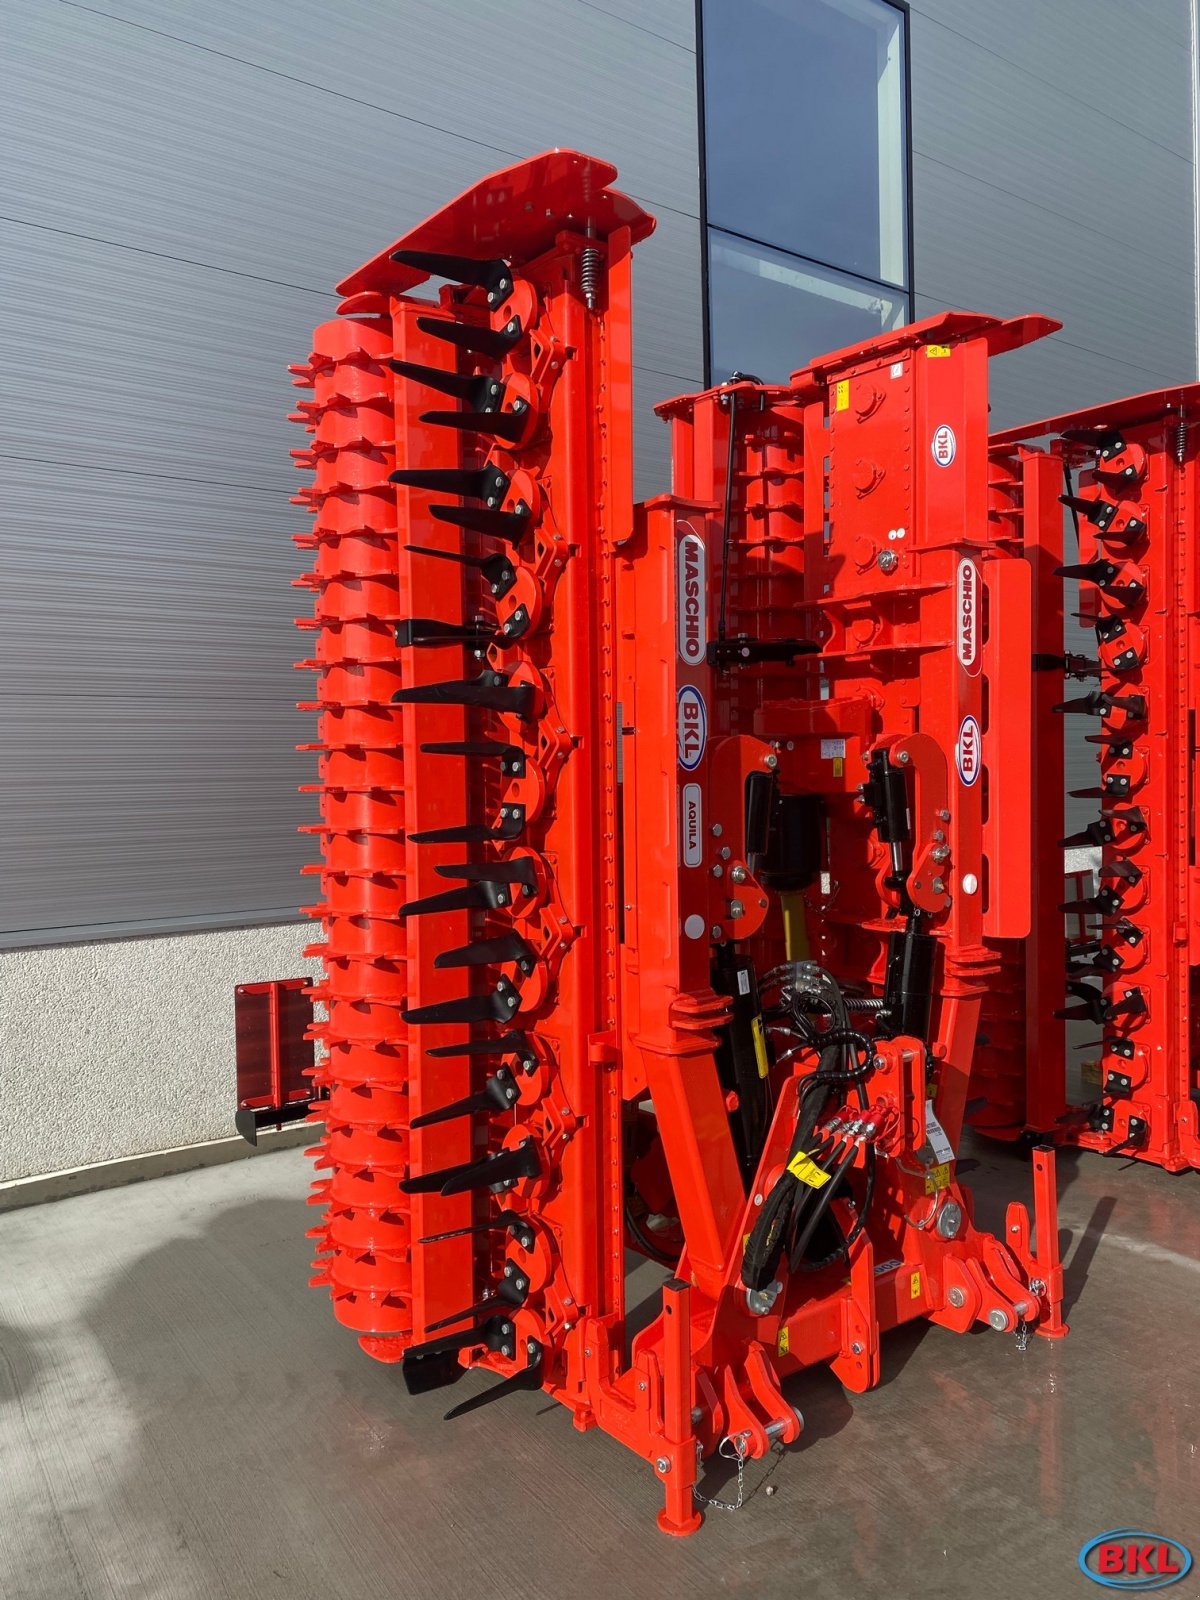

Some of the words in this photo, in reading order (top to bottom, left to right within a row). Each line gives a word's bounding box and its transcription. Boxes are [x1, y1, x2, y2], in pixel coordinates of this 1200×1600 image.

[938, 431, 949, 459] BKL
[685, 541, 700, 657] MASCHIO
[962, 565, 973, 660] MASCHIO
[684, 703, 700, 759] BKL
[962, 725, 974, 772] BKL
[688, 801, 697, 850] AQUILA
